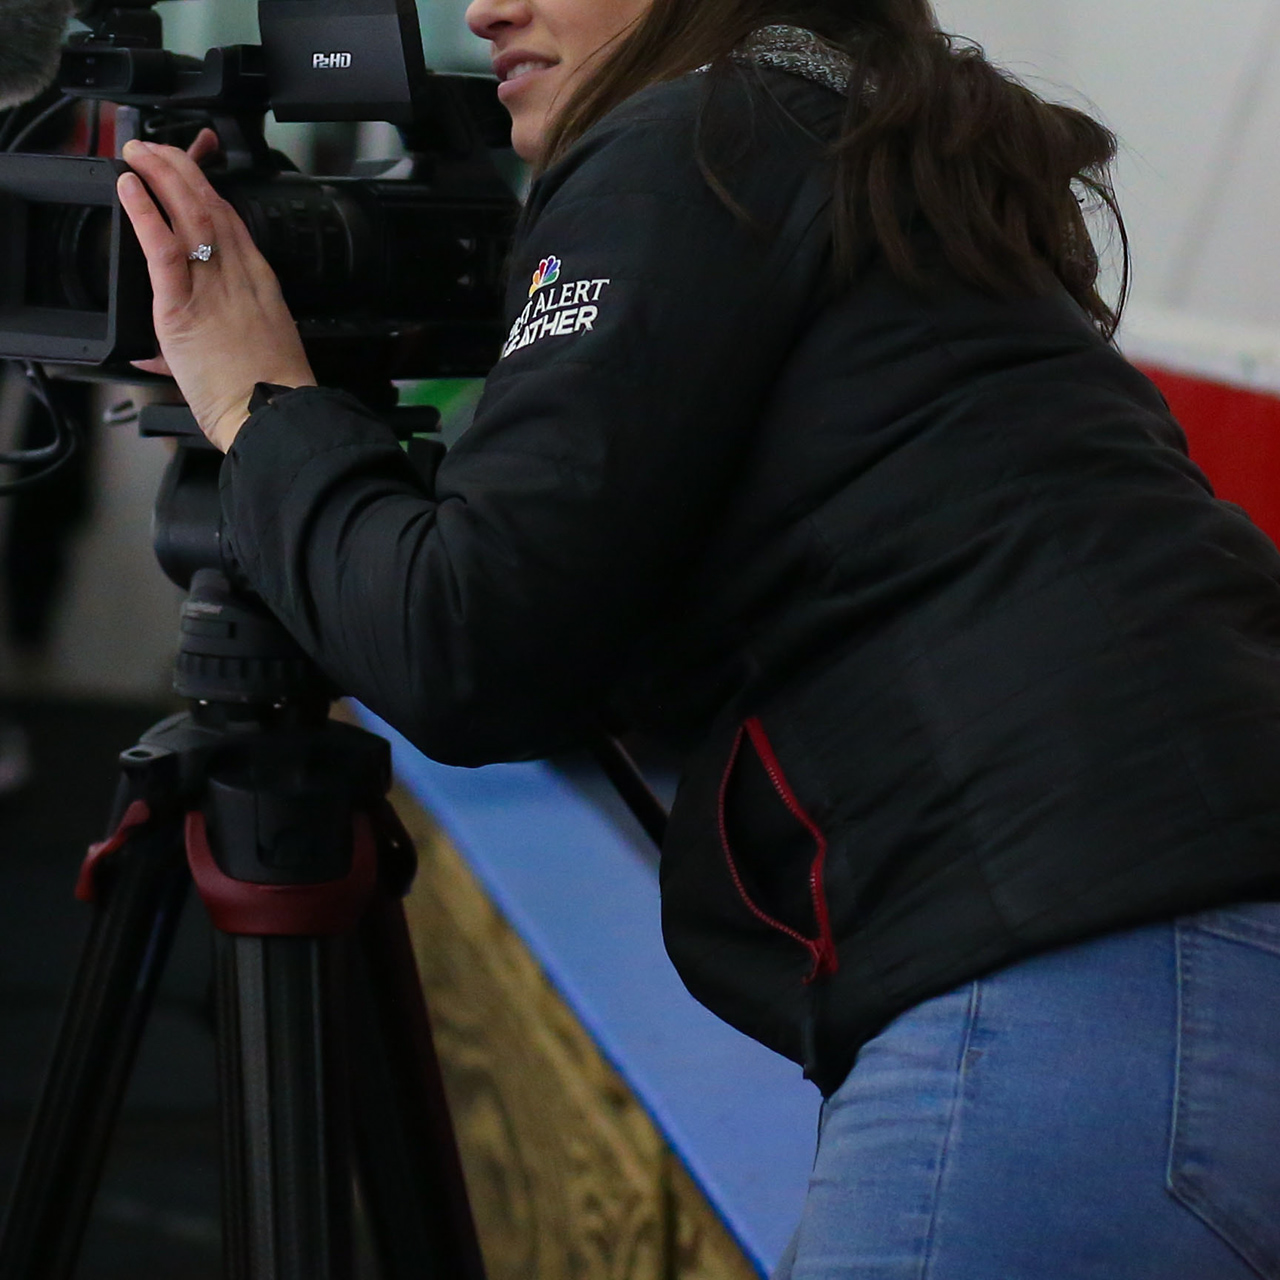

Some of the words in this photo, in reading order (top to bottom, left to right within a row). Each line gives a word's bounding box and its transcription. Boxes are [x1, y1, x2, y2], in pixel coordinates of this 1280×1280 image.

[312, 52, 352, 69] P2HD
[532, 278, 610, 318] ALERT
[500, 305, 598, 359] EATHER
